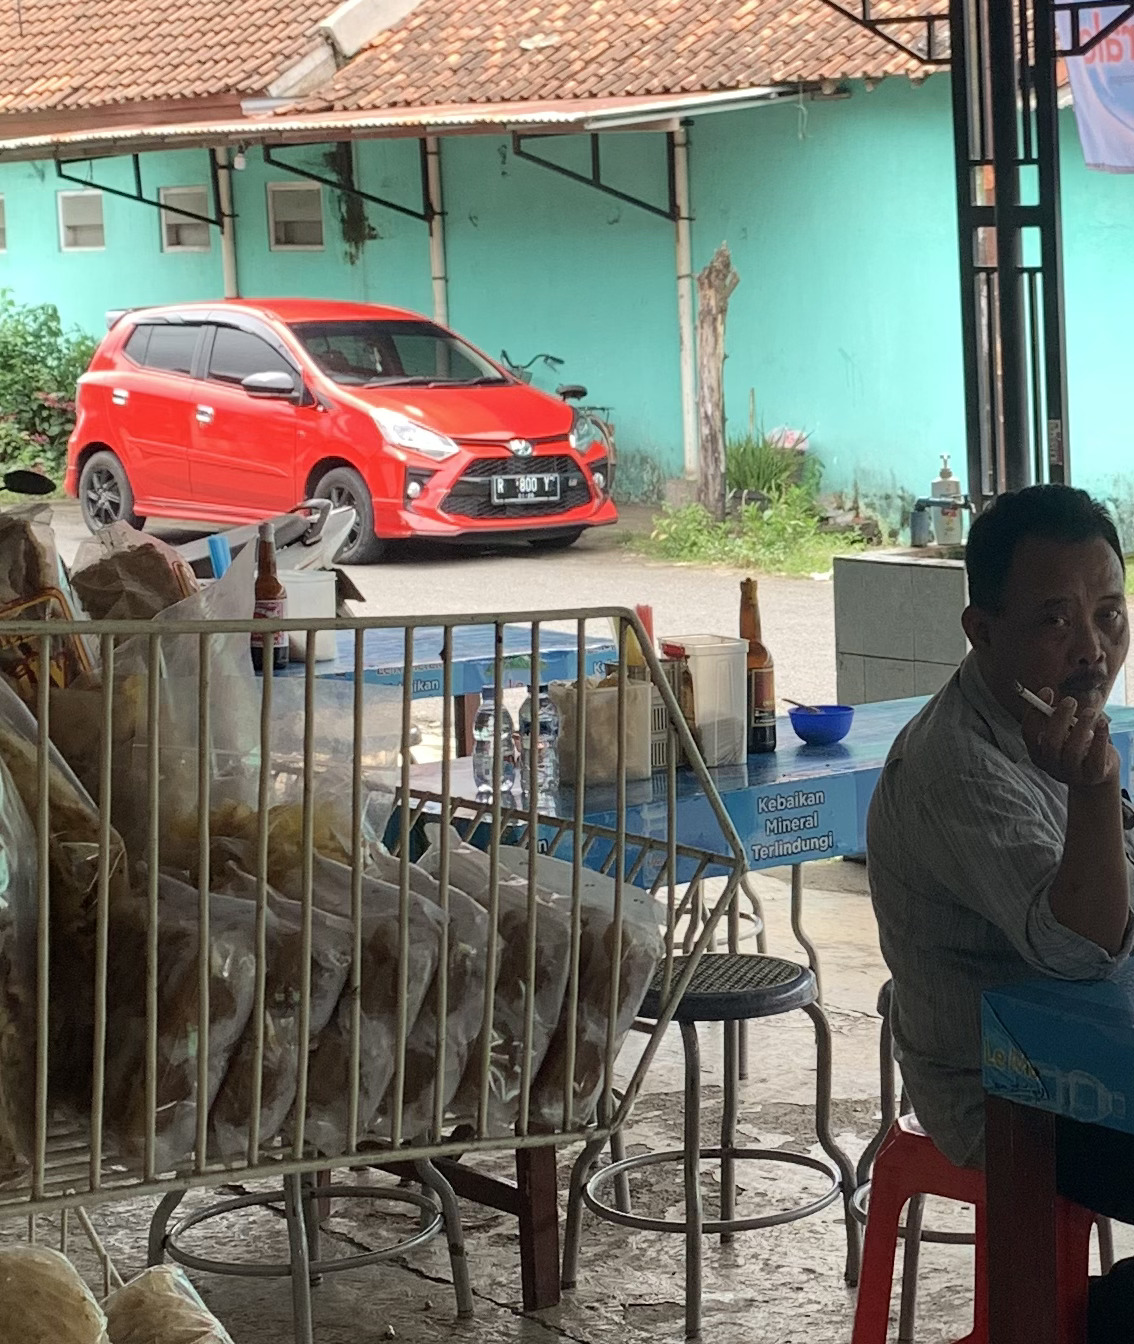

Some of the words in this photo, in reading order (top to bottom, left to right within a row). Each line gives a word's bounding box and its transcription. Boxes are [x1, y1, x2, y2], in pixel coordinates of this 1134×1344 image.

[497, 478, 504, 494] R
[757, 791, 825, 814] Kebaikan
[765, 811, 819, 835] Mineral
[751, 832, 834, 860] Terlindungi
